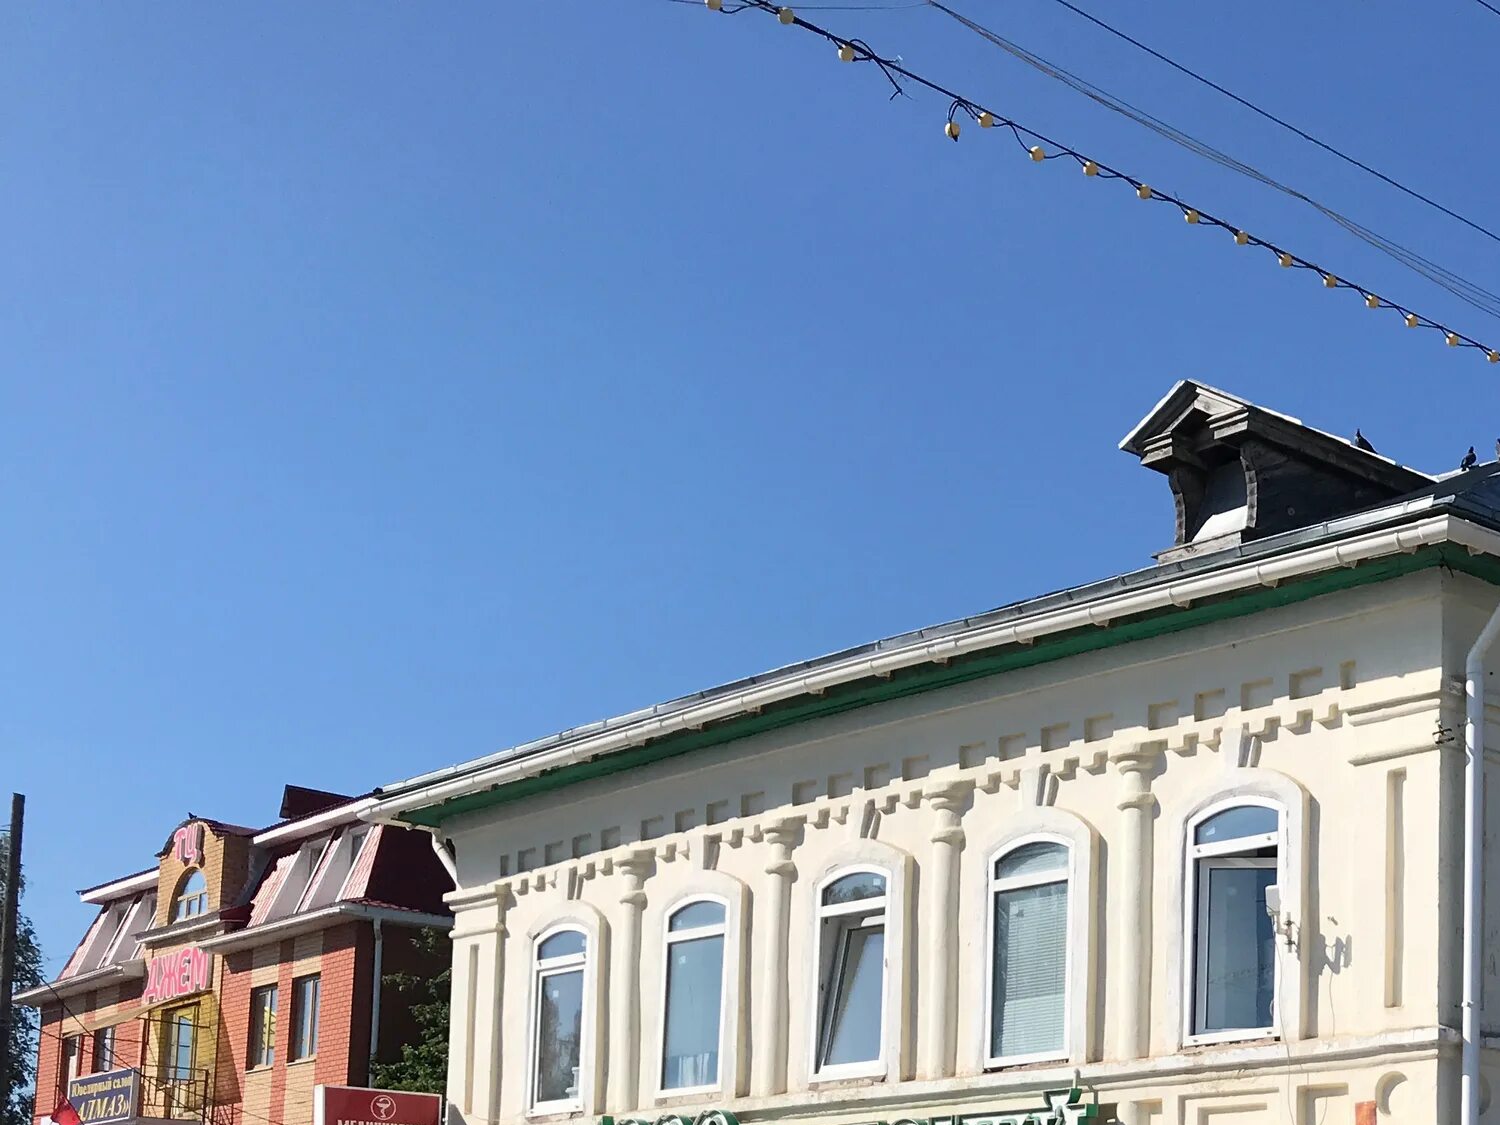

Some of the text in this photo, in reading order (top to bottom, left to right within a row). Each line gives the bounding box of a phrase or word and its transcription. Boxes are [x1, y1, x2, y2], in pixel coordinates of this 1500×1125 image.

[174, 823, 198, 864] ТЦ
[143, 947, 209, 1005] ДЖЕМ
[71, 1076, 112, 1097] Ювелирный
